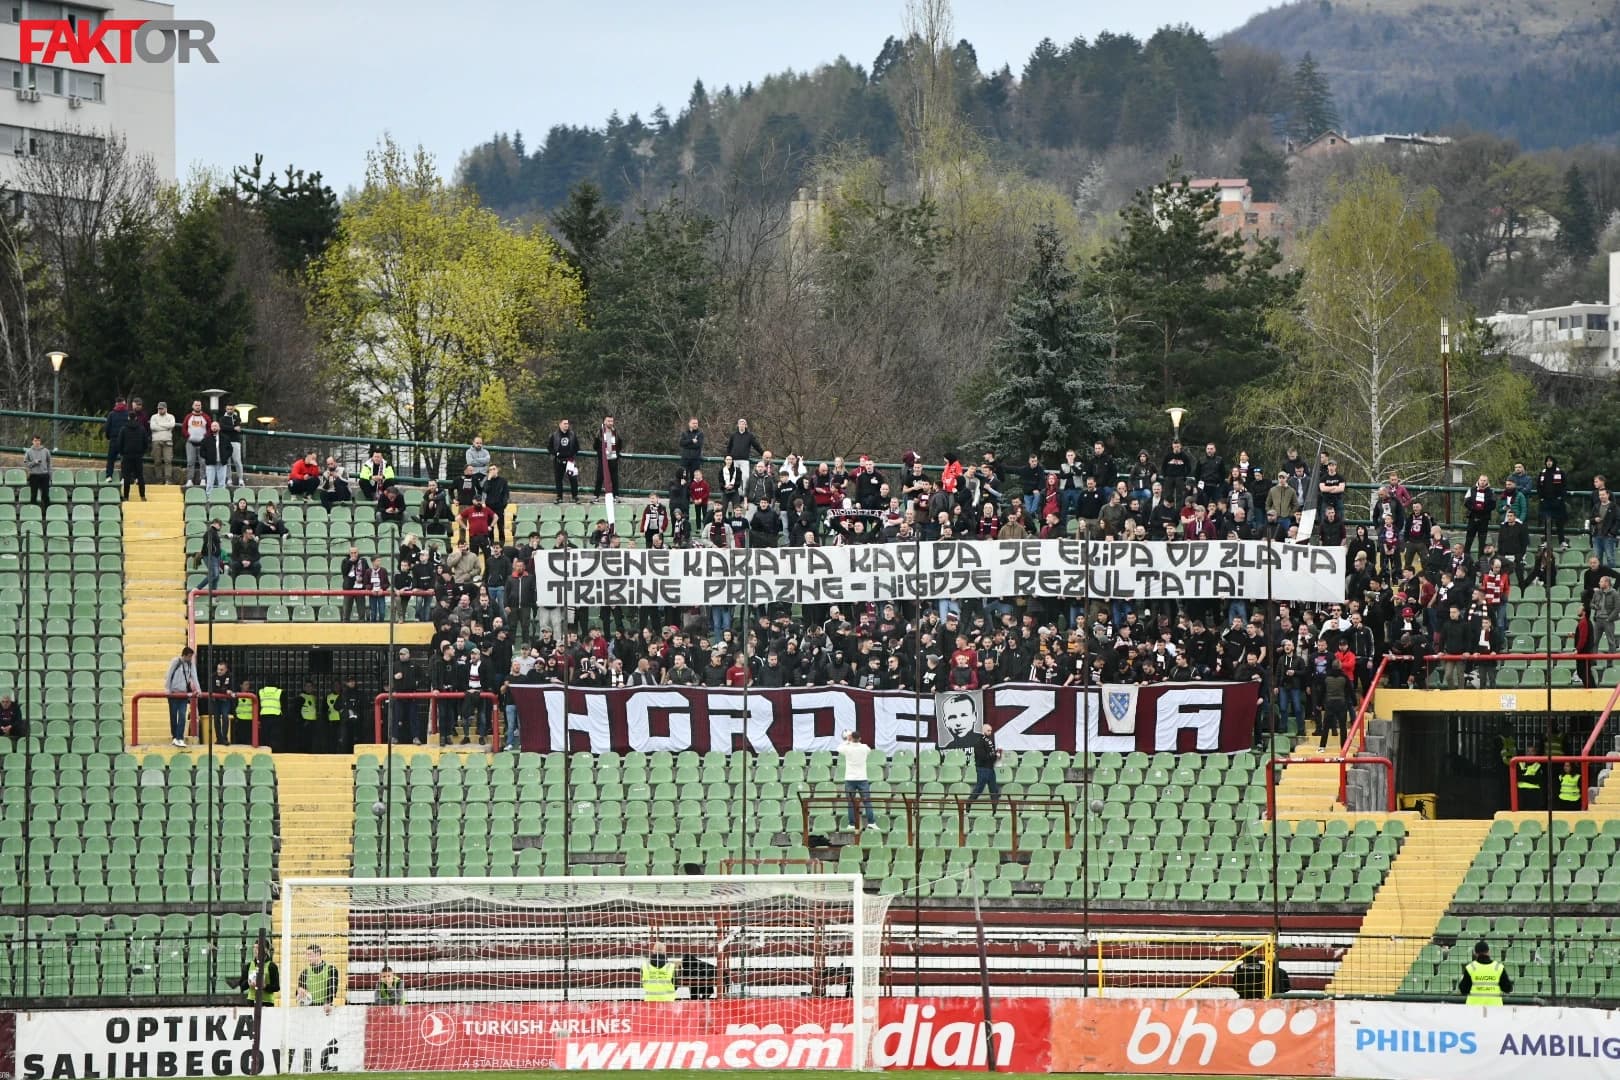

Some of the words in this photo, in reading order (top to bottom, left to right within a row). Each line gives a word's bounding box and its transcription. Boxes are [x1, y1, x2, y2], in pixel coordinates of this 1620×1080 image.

[683, 548, 833, 577] KARATA
[850, 544, 919, 573] KAO
[933, 542, 981, 570] DA
[1000, 541, 1041, 566] JE
[1166, 542, 1209, 567] OD
[1220, 542, 1336, 574] ZLATA
[1013, 570, 1244, 597] REZULTATA!
[543, 690, 936, 755] HORDE
[993, 686, 1223, 753] ZLA
[106, 1014, 255, 1044] OPTIKA
[462, 1020, 544, 1035] TURKISH
[549, 1018, 632, 1034] AIRLINES
[1127, 1008, 1218, 1065] bh
[1356, 1029, 1477, 1055] PHILIPS
